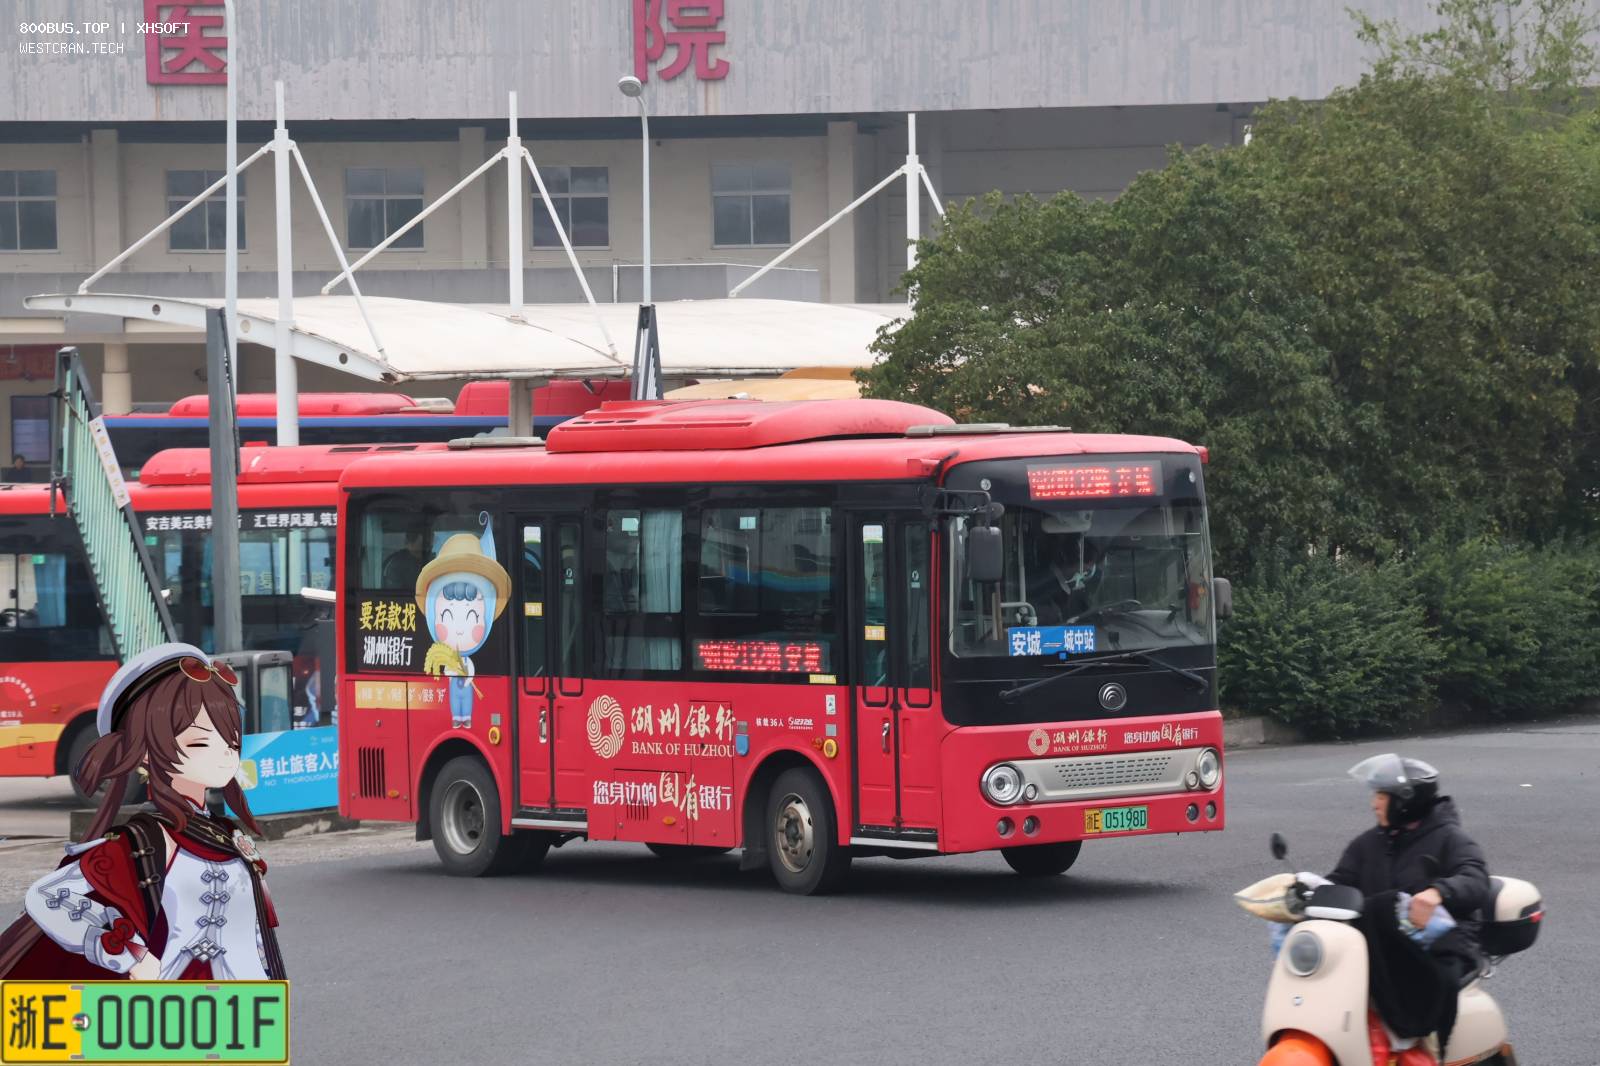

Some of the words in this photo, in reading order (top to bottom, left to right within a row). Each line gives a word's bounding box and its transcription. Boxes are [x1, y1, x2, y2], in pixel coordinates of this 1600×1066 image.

[143, 0, 228, 85] 医
[633, 0, 730, 83] 院
[360, 601, 417, 633] 要存款找
[363, 635, 414, 667] 湖州银行
[1012, 631, 1042, 656] 安城
[1064, 629, 1095, 651] 城中站
[1123, 722, 1198, 746] 您身边的国有银行
[632, 741, 663, 756] BANK
[665, 743, 681, 756] OF
[684, 743, 735, 758] HUZHOU
[593, 772, 733, 821] 您身边的国有银行
[1105, 807, 1147, 830] 05198D
